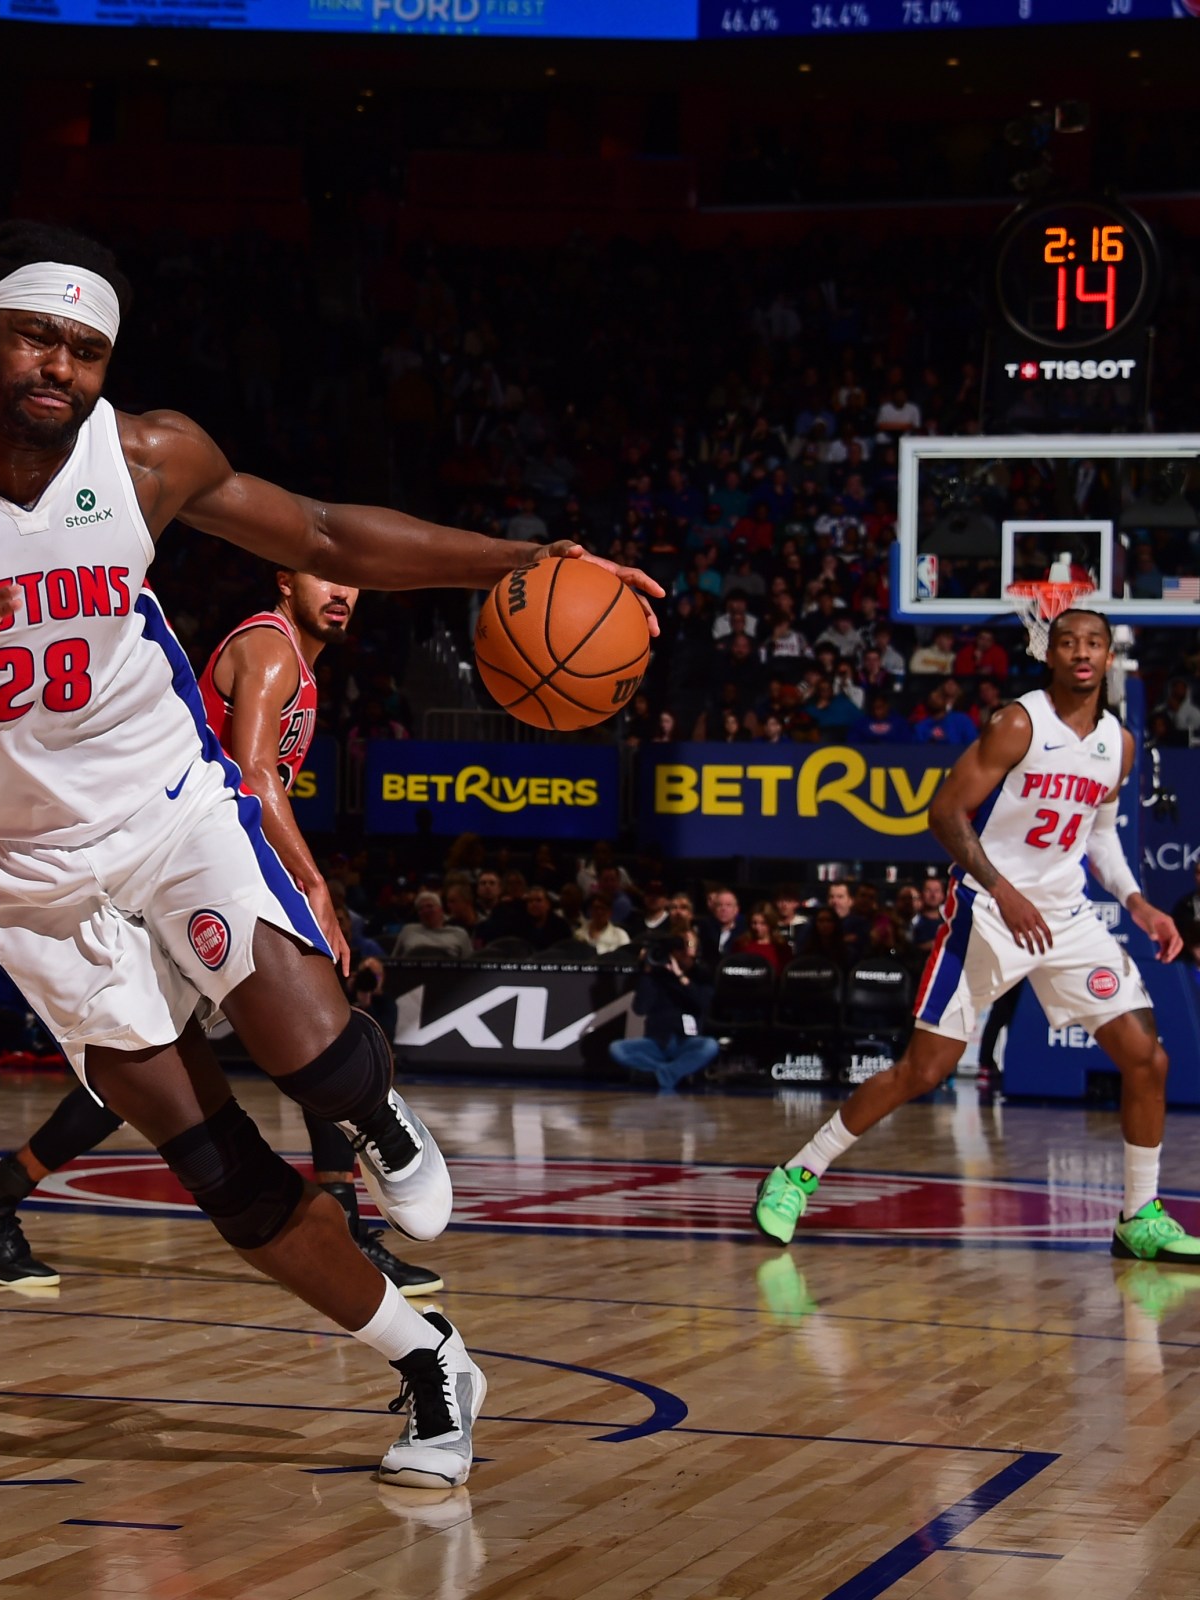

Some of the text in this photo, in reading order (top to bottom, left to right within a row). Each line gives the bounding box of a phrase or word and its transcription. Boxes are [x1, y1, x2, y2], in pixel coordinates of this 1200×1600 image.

[371, 0, 479, 22] FORD
[485, 1, 544, 16] FIRST
[1044, 225, 1125, 264] 2:16
[1056, 264, 1116, 331] 14
[1039, 359, 1136, 380] TISSOT
[65, 507, 113, 529] StockX
[654, 745, 949, 835] BETRIV
[1024, 808, 1083, 852] 24
